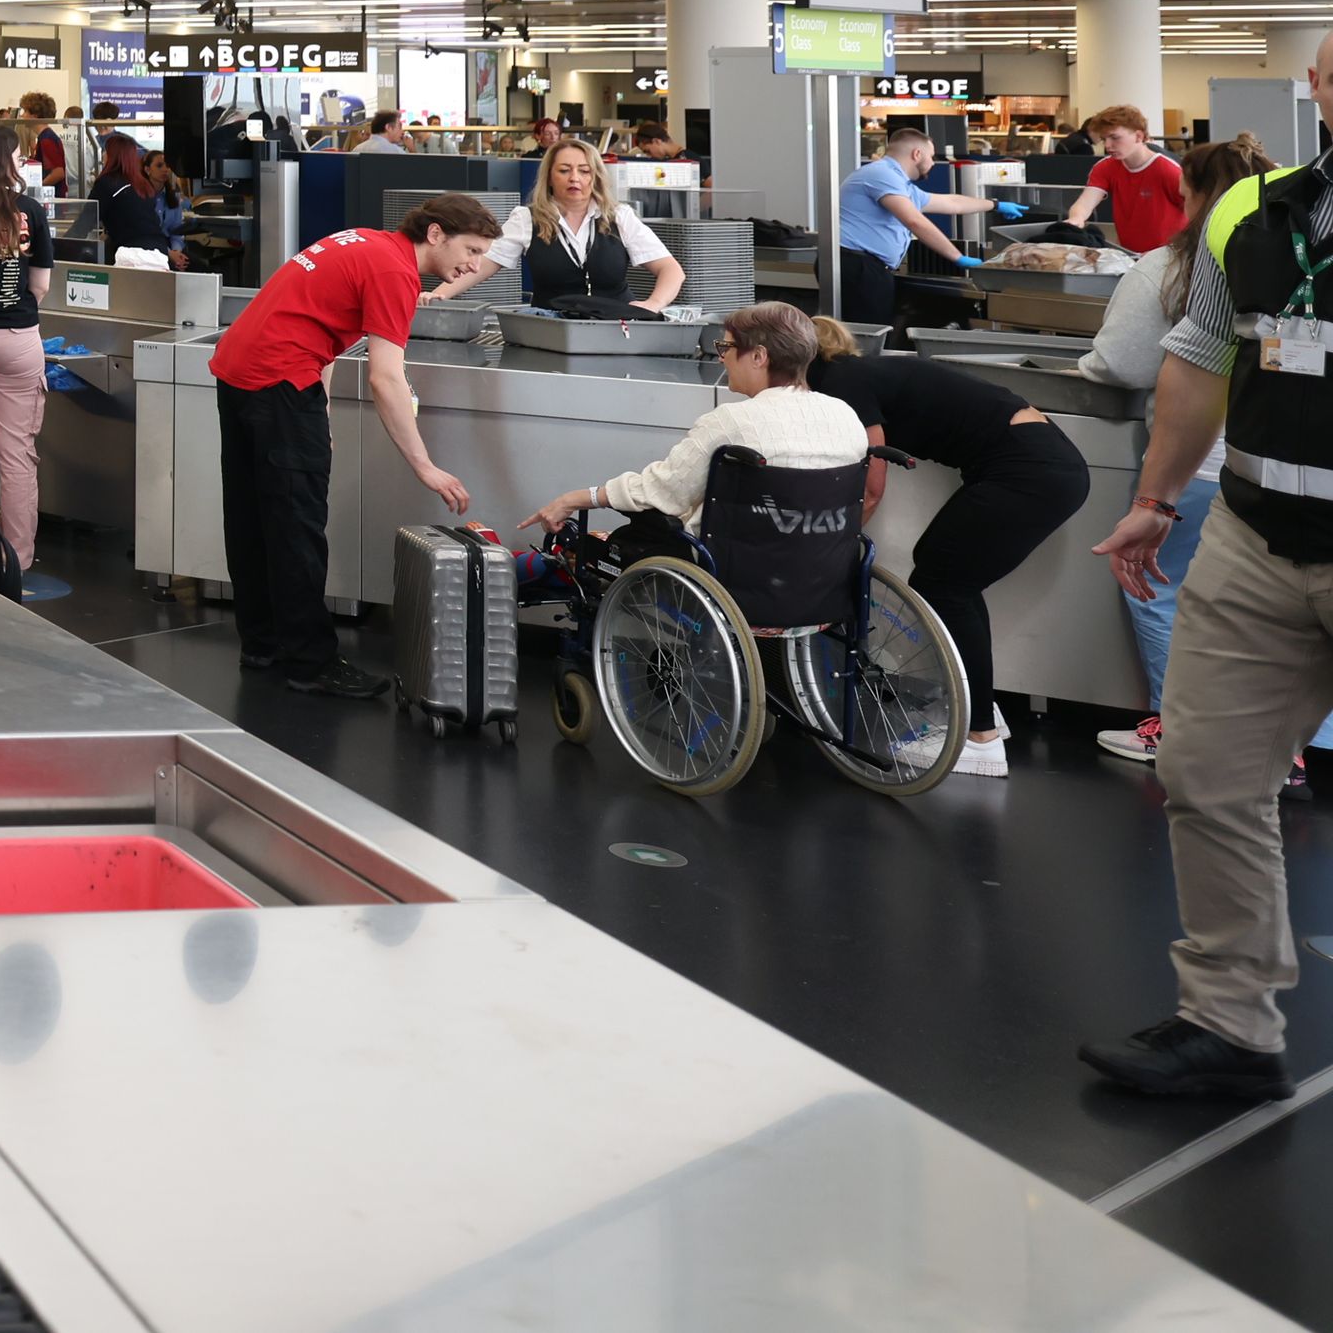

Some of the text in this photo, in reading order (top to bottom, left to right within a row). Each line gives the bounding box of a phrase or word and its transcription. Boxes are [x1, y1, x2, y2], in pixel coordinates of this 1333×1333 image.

[791, 15, 828, 34] Economy
[839, 17, 878, 35] Economy
[774, 24, 784, 53] 5
[791, 34, 813, 51] Class
[839, 36, 861, 53] Class
[883, 29, 894, 57] 6
[88, 41, 114, 62] This
[117, 42, 128, 62] is
